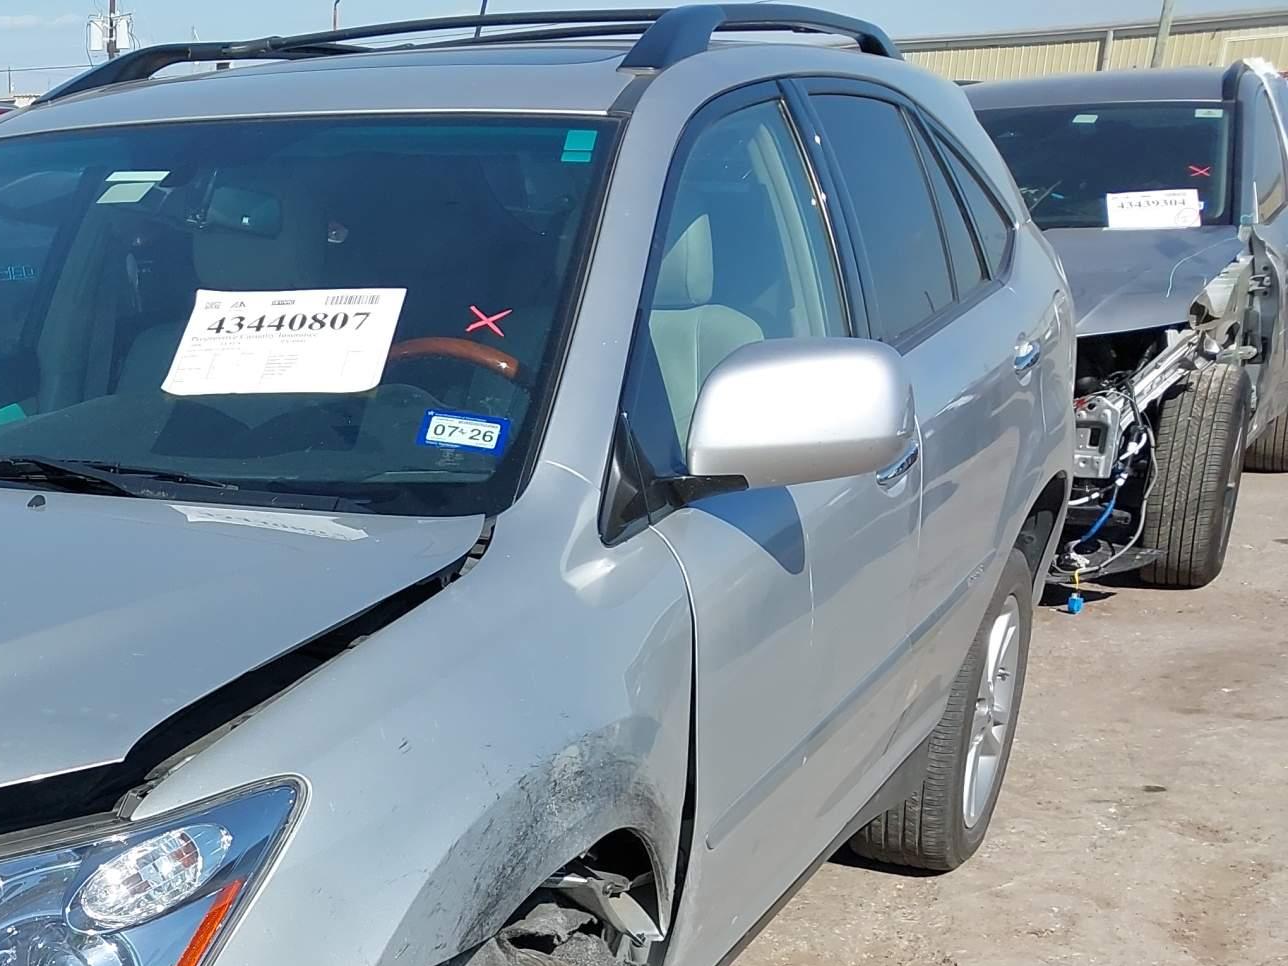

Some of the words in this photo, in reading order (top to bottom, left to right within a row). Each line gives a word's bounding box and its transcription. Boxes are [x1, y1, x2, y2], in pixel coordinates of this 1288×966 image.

[207, 312, 370, 334] 43440807
[433, 424, 459, 437] 07
[468, 428, 495, 443] 26
